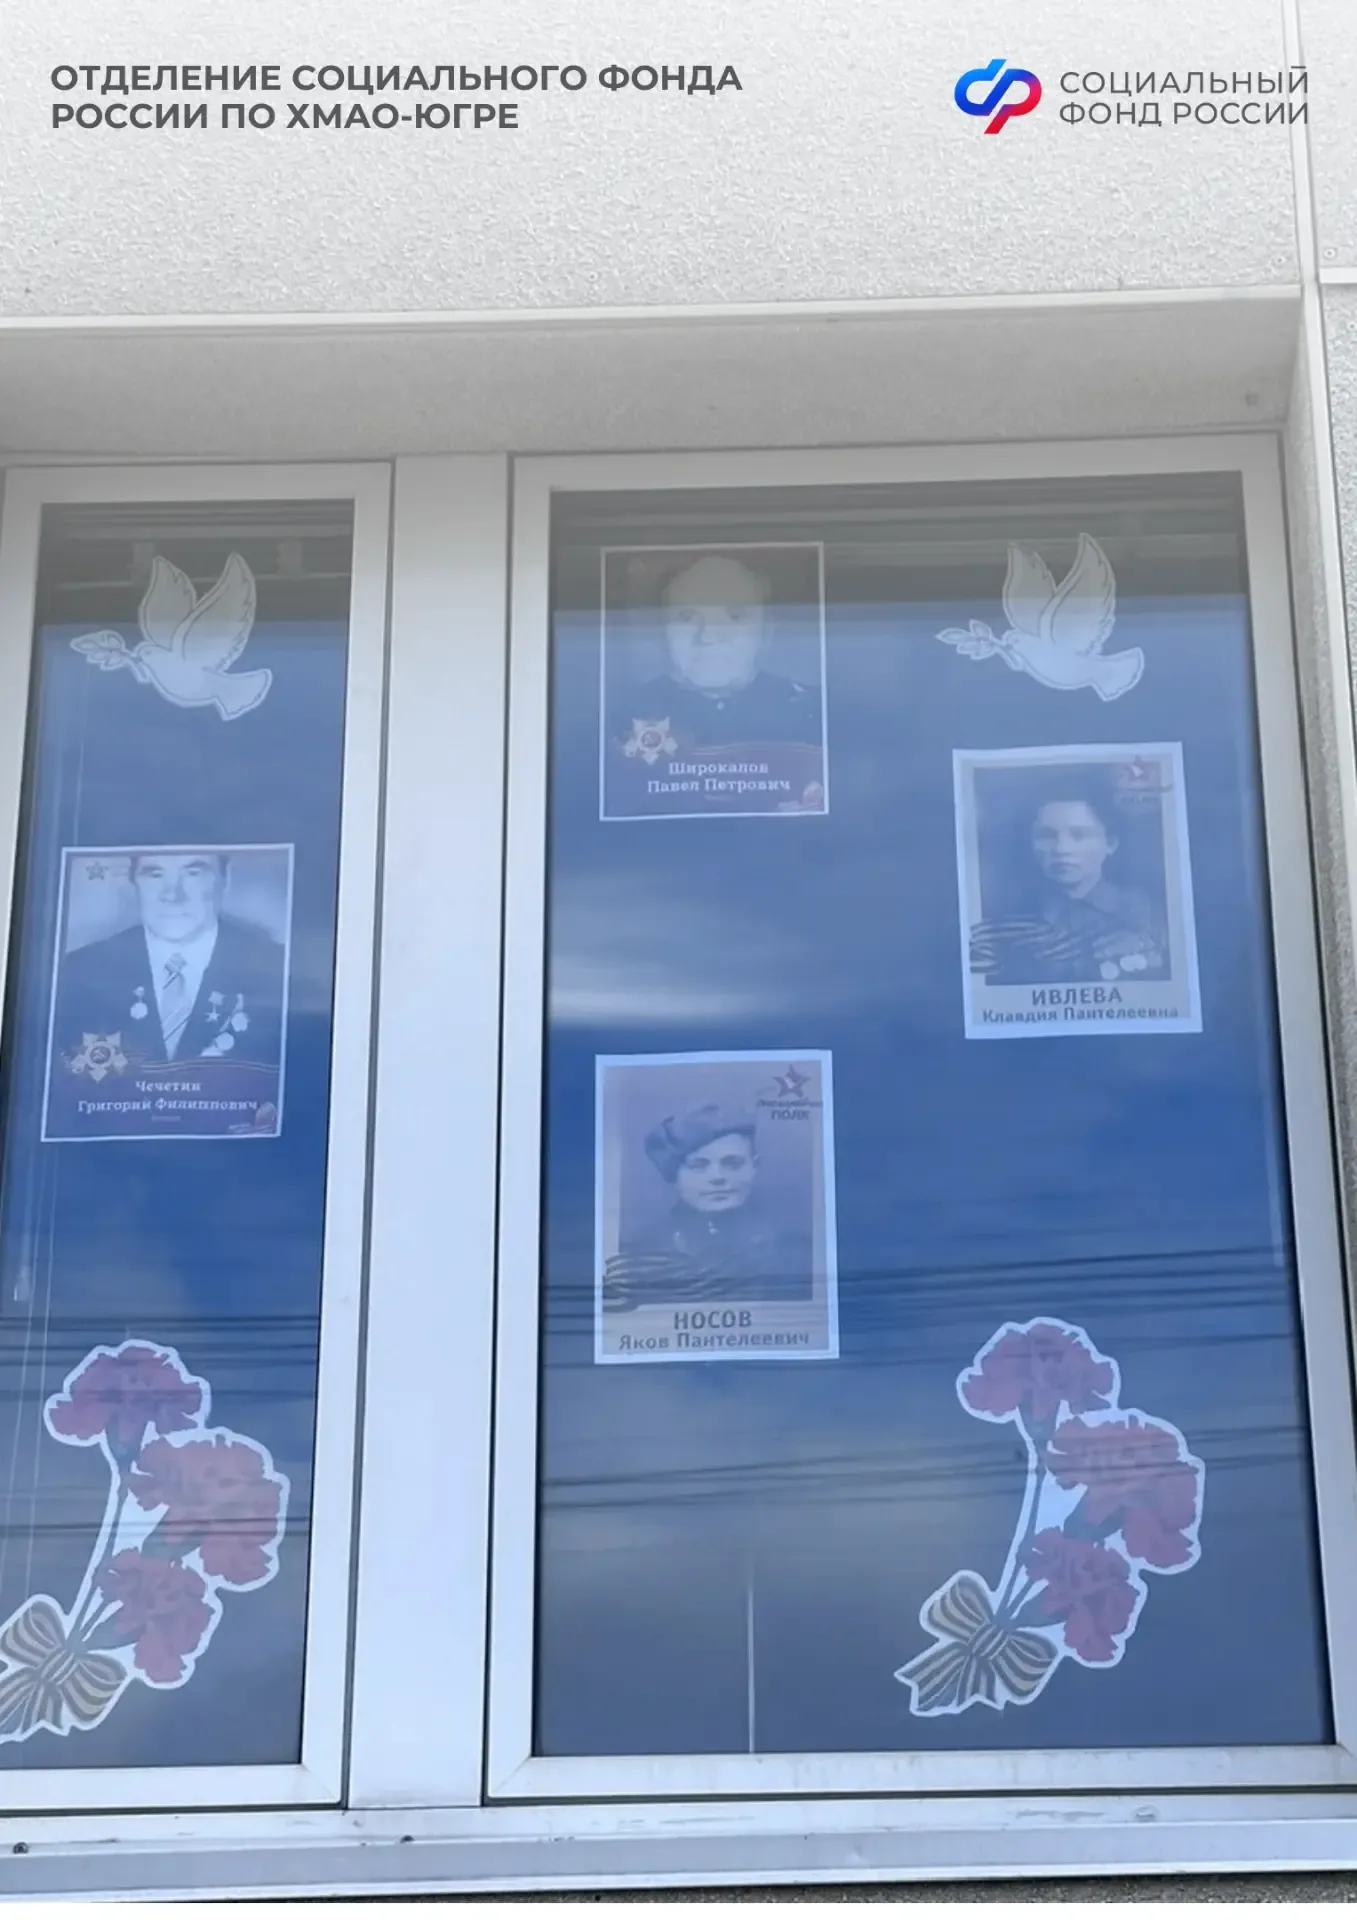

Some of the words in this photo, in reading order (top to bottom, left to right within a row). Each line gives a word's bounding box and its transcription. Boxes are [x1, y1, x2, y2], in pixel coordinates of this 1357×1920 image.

[647, 780, 700, 793] Павел
[703, 778, 791, 793] Петрович
[1031, 987, 1123, 1006] ИВЛЕВА
[983, 1009, 1058, 1024] Клавдия
[1063, 1006, 1178, 1021] Пантелеевна
[77, 1098, 151, 1115] Григорий
[673, 1310, 752, 1330] НОСОВ
[618, 1334, 670, 1350] Яков
[676, 1331, 810, 1348] Пантелеевич
